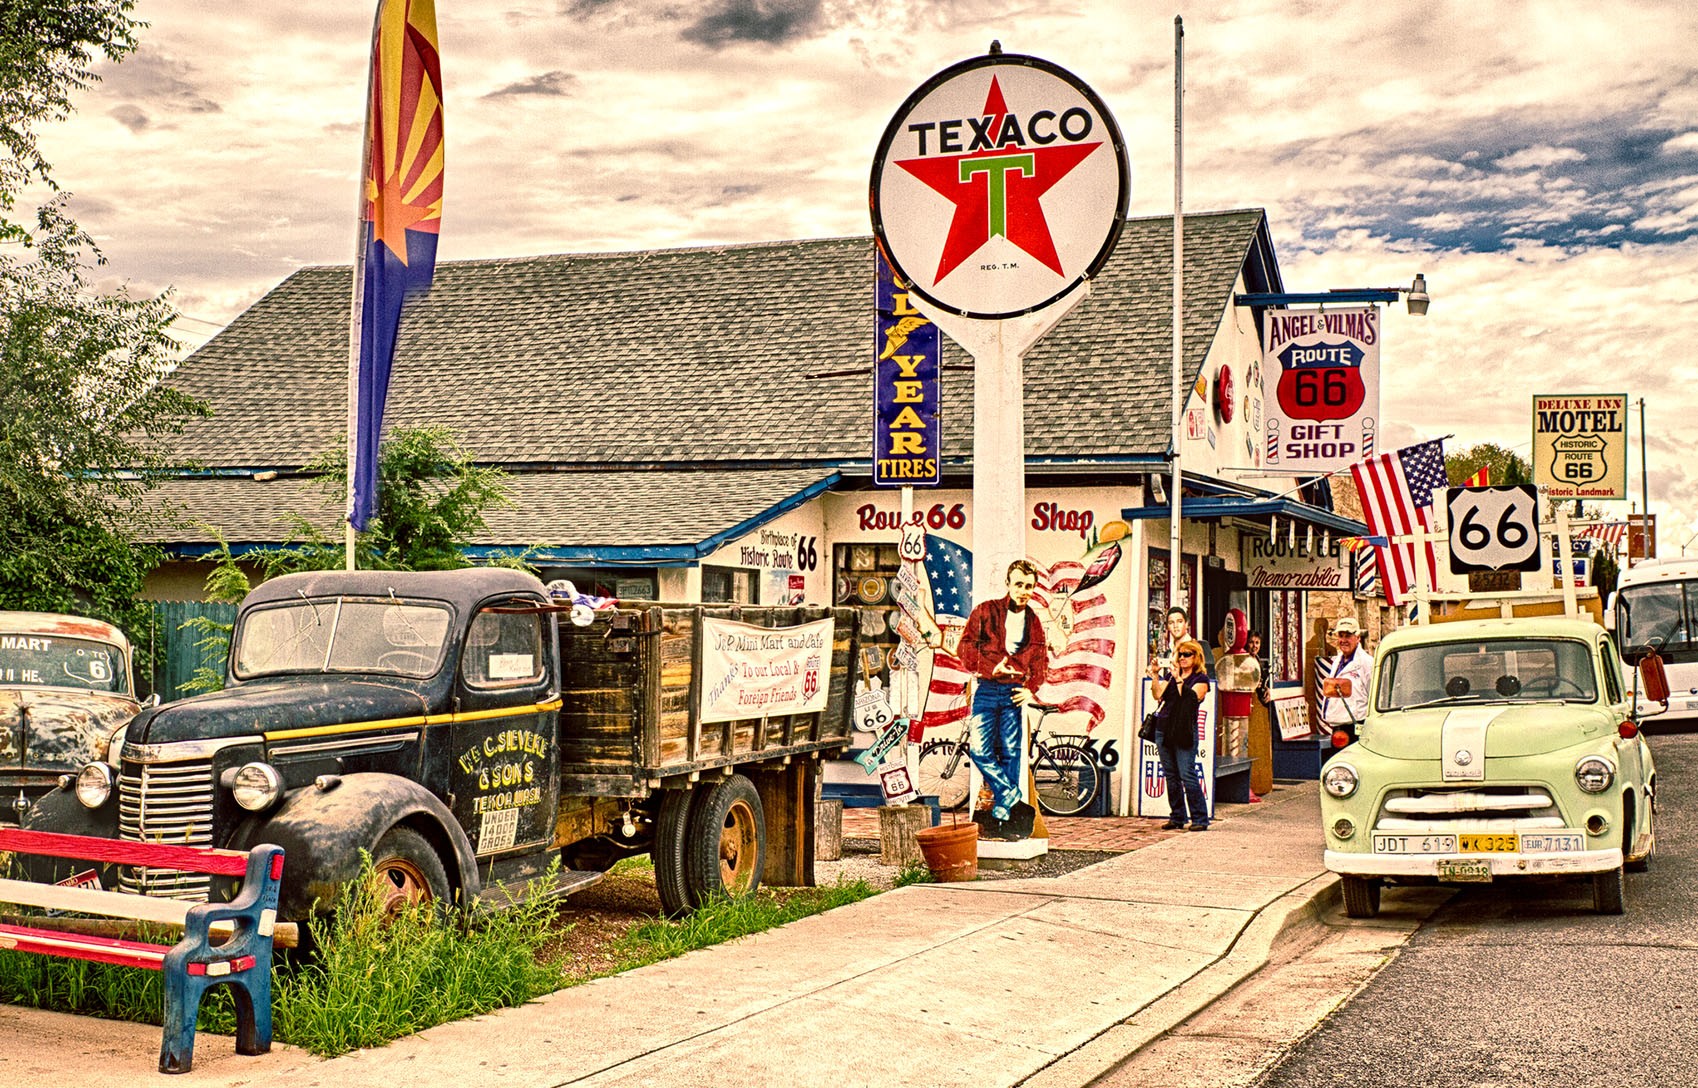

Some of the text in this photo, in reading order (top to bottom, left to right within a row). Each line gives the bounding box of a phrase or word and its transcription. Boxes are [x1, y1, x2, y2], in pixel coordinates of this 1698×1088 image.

[908, 106, 1093, 157] TEXACO
[980, 264, 999, 272] REG.
[1268, 309, 1377, 353] ANGEL & VILMA'S
[1291, 347, 1352, 369] ROUTE
[1295, 369, 1348, 407] 66
[1538, 398, 1623, 411] DELUXE INN
[1537, 410, 1623, 433] MOTEL
[1291, 424, 1345, 440] GIFT
[1286, 442, 1356, 459] SHOP
[1560, 440, 1598, 449] HISTORIC
[1565, 453, 1594, 461] ROUTE
[878, 459, 938, 479] TIRES
[1565, 463, 1593, 478] 66
[1549, 487, 1616, 497] istoric Landmark
[857, 501, 1094, 541] Roue 66 Shop
[1459, 502, 1529, 551] 66
[760, 529, 798, 551] Birthplace of
[904, 532, 922, 555] 66
[740, 535, 818, 572] Historic Route 66
[1252, 565, 1341, 588] Memorabilia
[1, 636, 52, 652] MART
[736, 635, 759, 651] Mini
[760, 633, 784, 650] Mart
[769, 661, 792, 677] Local
[804, 669, 817, 693] 66
[739, 686, 798, 709] Foreign Friends
[855, 692, 882, 706] ARIZONA
[863, 709, 887, 728] 66
[479, 767, 490, 790] &
[890, 781, 906, 792] 66
[484, 810, 517, 825] UNDER
[1378, 838, 1409, 852] JDT
[1485, 837, 1516, 852] 325
[1544, 837, 1582, 851] 7131
